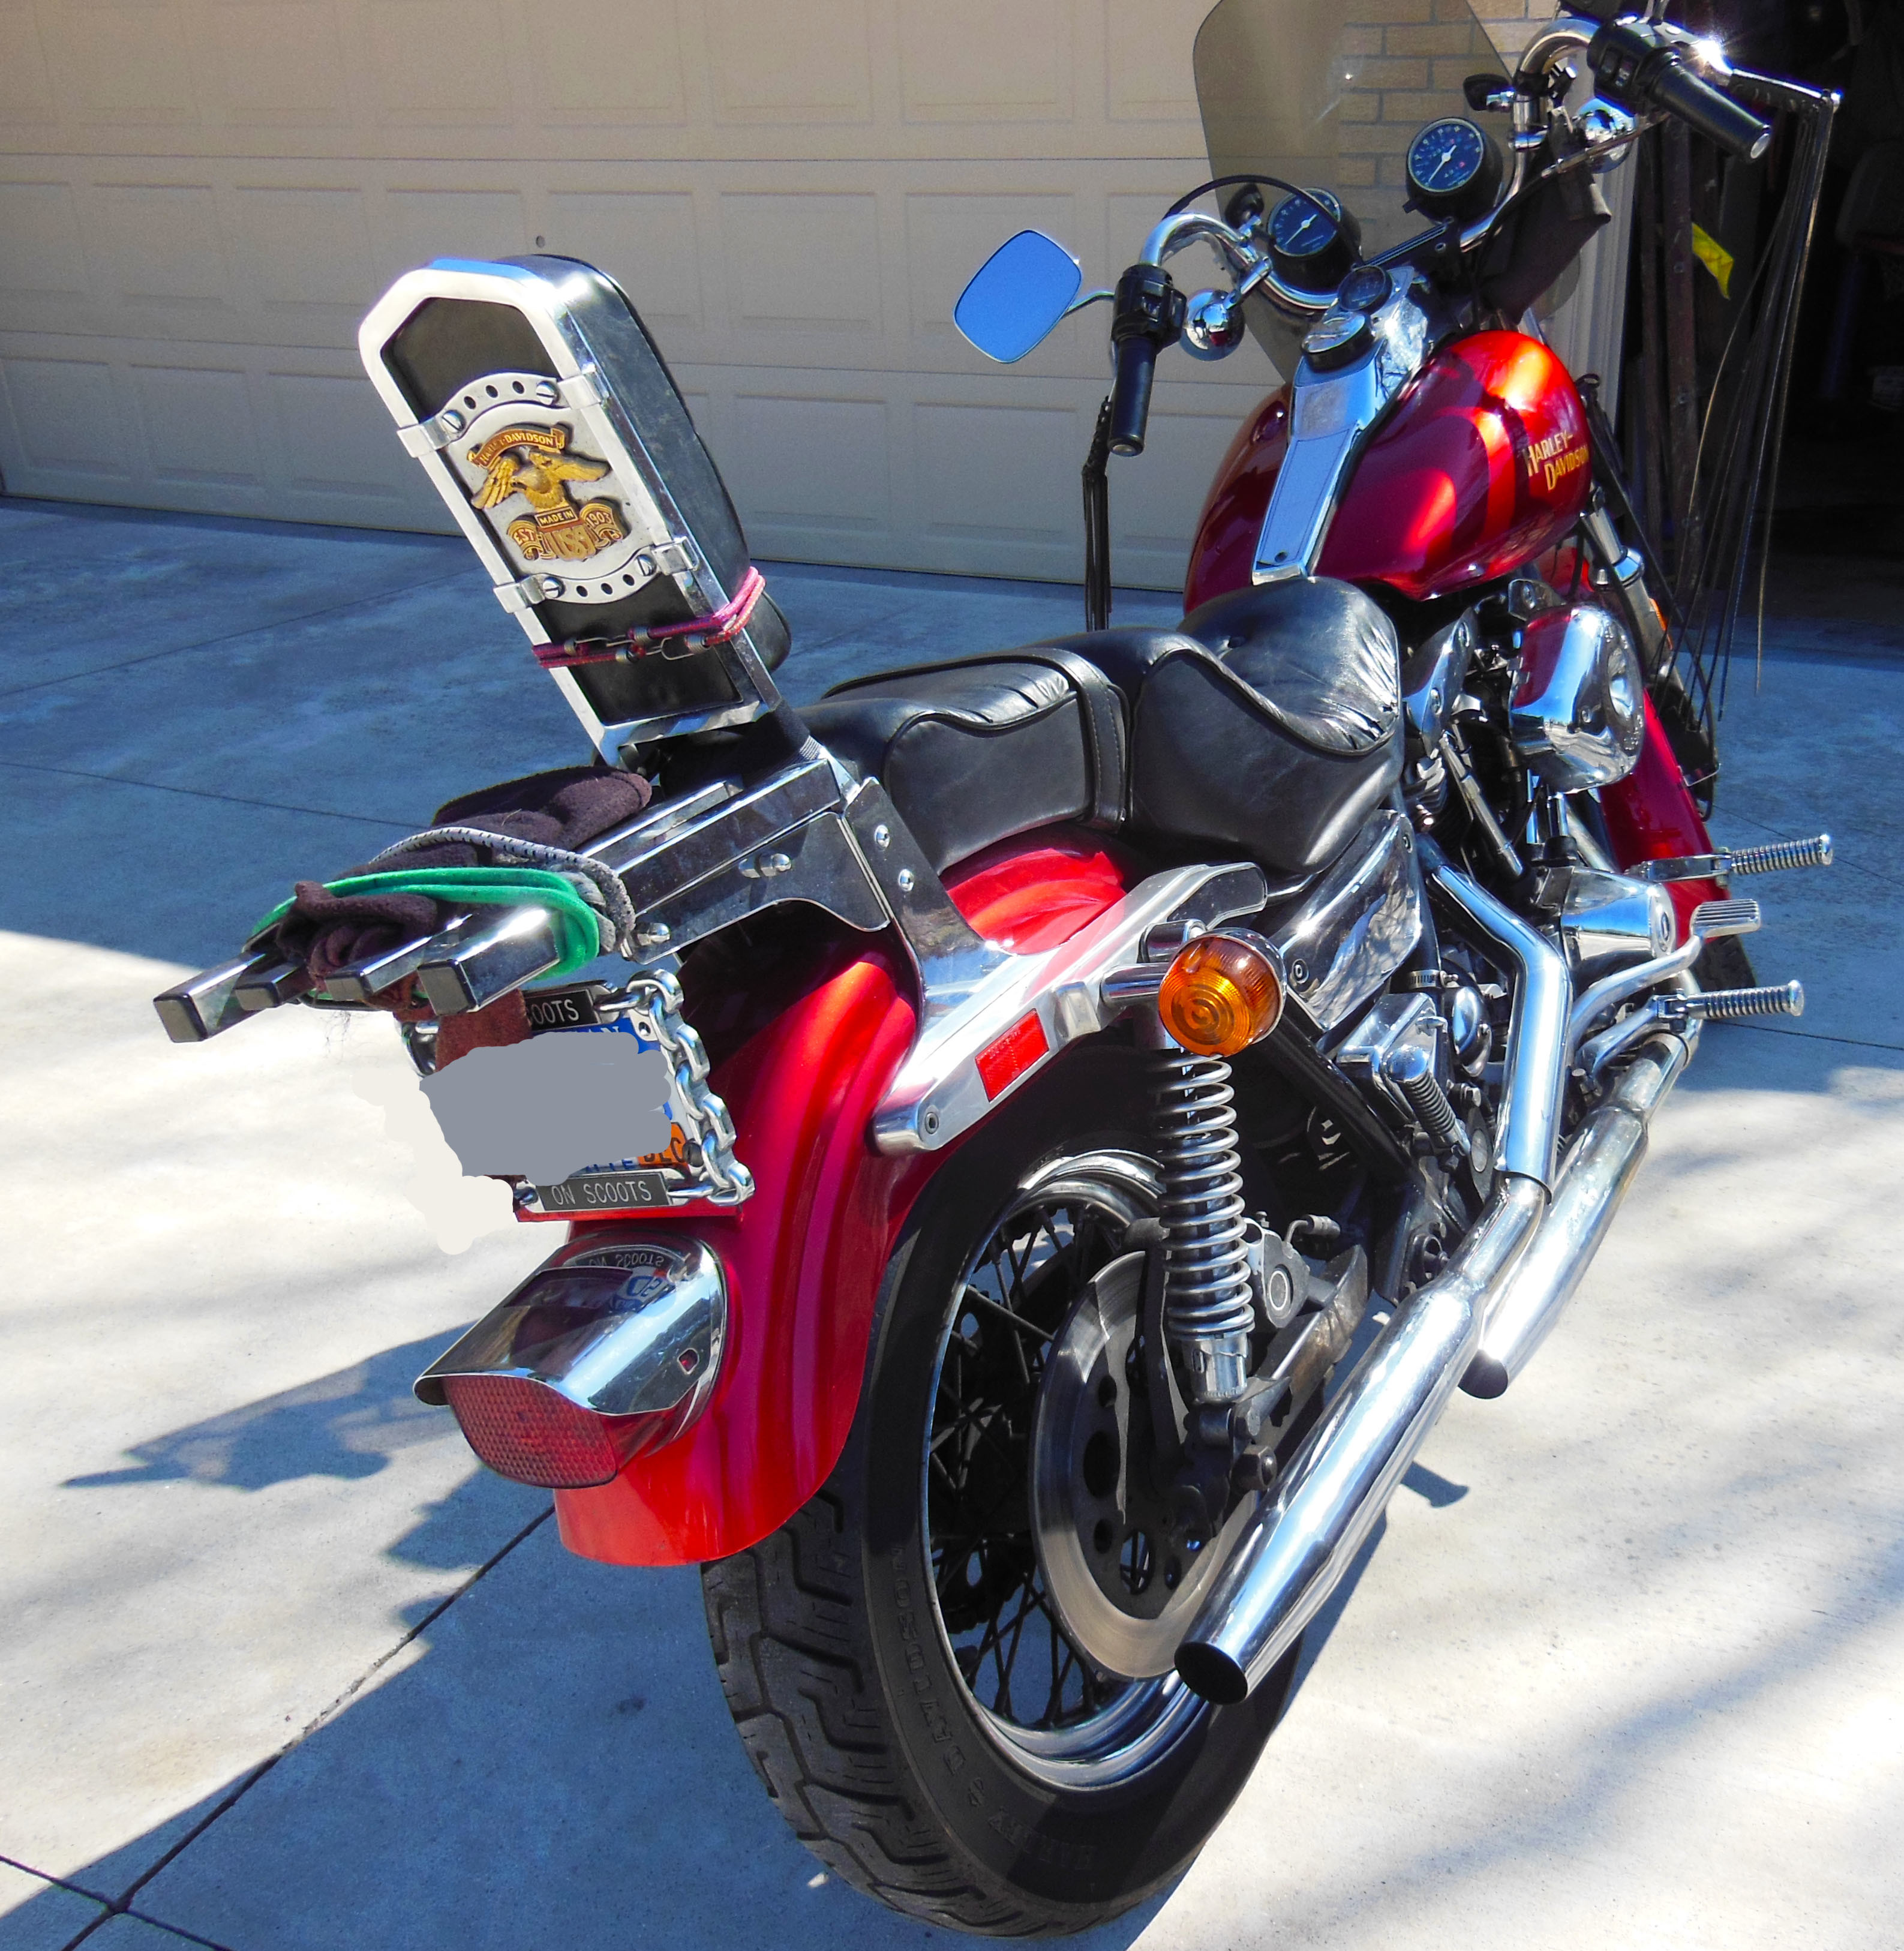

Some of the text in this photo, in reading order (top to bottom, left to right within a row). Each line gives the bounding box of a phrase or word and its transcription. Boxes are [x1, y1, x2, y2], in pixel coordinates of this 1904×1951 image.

[540, 510, 574, 525] MADE IN
[586, 511, 612, 527] 1903
[513, 528, 535, 546] EST
[530, 999, 579, 1025] OOTS
[551, 1180, 652, 1205] ON SCOOTS
